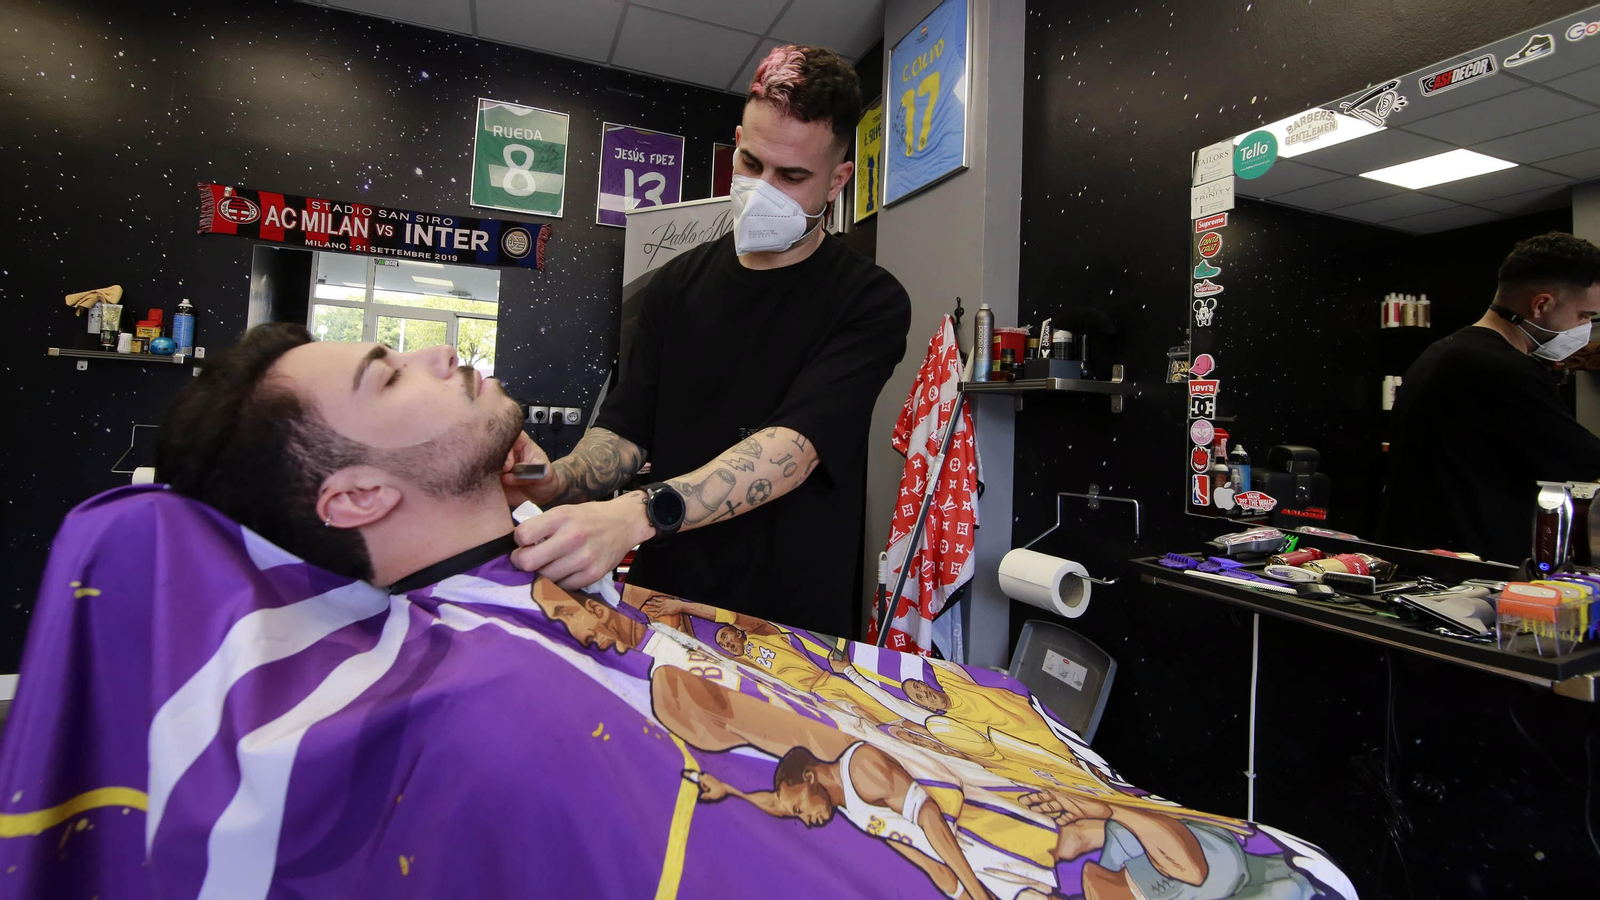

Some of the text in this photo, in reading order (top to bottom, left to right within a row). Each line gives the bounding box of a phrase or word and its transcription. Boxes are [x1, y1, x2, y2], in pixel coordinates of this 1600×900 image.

[1567, 22, 1600, 41] Go
[901, 71, 941, 157] 17
[1286, 110, 1334, 135] BARBERS
[493, 125, 543, 141] RUEDA
[1285, 121, 1336, 145] GENTLEMEN
[614, 147, 675, 166] JESÚS FDEZ
[1197, 149, 1229, 167] TAILORS
[1240, 141, 1268, 161] Tello
[502, 143, 536, 197] 8
[624, 168, 666, 209] 13
[1194, 187, 1231, 202] TRINITY
[311, 201, 454, 226] STADIO SAN SIRO
[1198, 216, 1224, 229] Supreme
[264, 205, 298, 230] AC
[301, 209, 369, 239] MILAN
[404, 222, 490, 252] INTER
[648, 219, 698, 258] Pablo
[305, 239, 347, 250] MILANO
[355, 244, 367, 252] 21
[370, 246, 432, 260] SETTEMBRE
[434, 253, 459, 262] 2019
[1200, 235, 1219, 246] SANTA
[1200, 243, 1218, 253] CRUZ
[755, 645, 777, 669] 24
